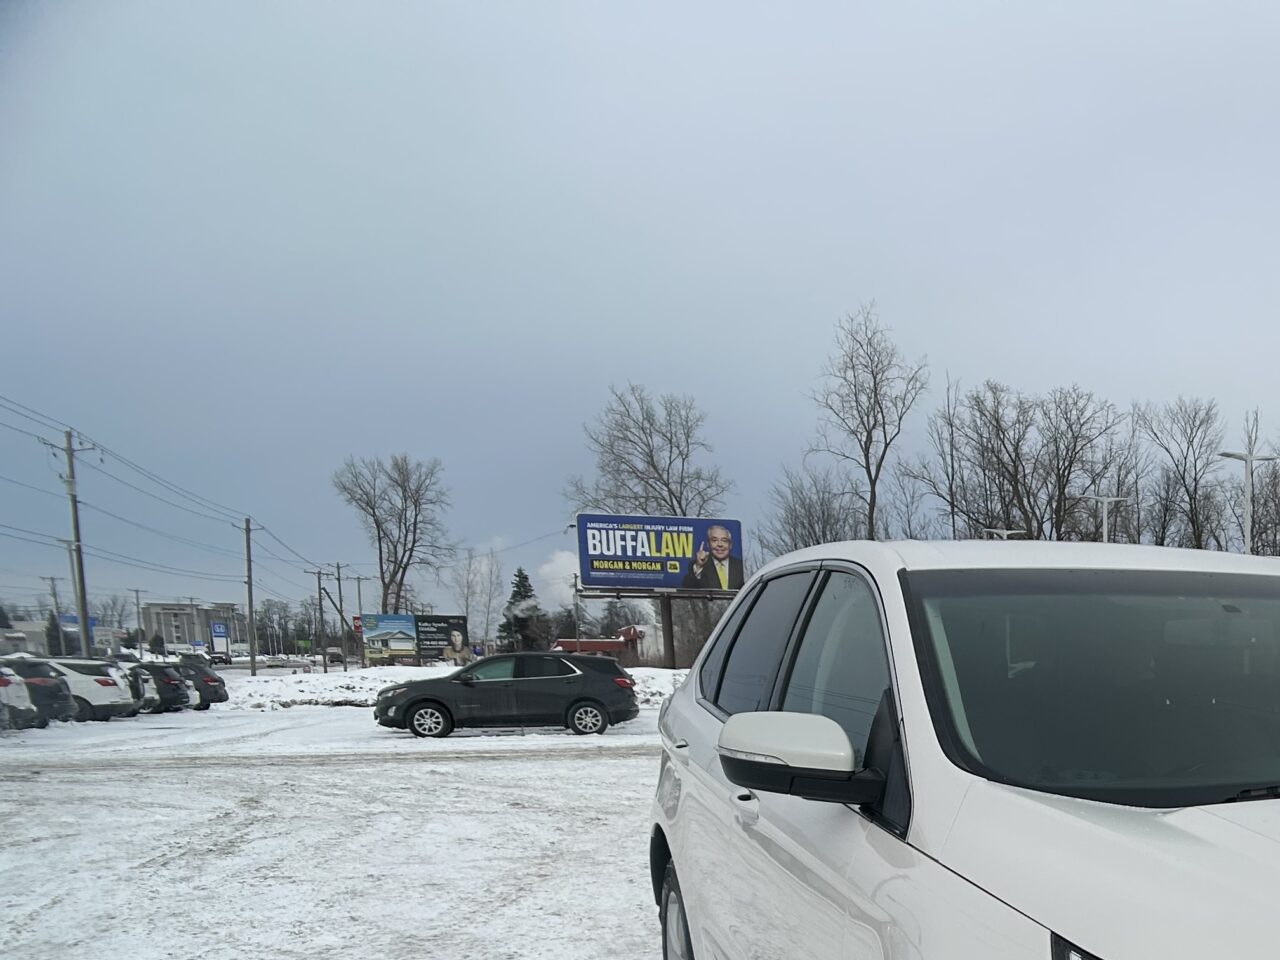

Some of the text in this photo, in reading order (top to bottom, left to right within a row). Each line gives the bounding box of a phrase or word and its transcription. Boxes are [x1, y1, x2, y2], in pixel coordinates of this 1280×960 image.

[586, 529, 694, 558] BUFFALAW
[593, 560, 623, 570] MORGAN
[624, 561, 630, 570] &
[631, 561, 662, 570] MORGAN
